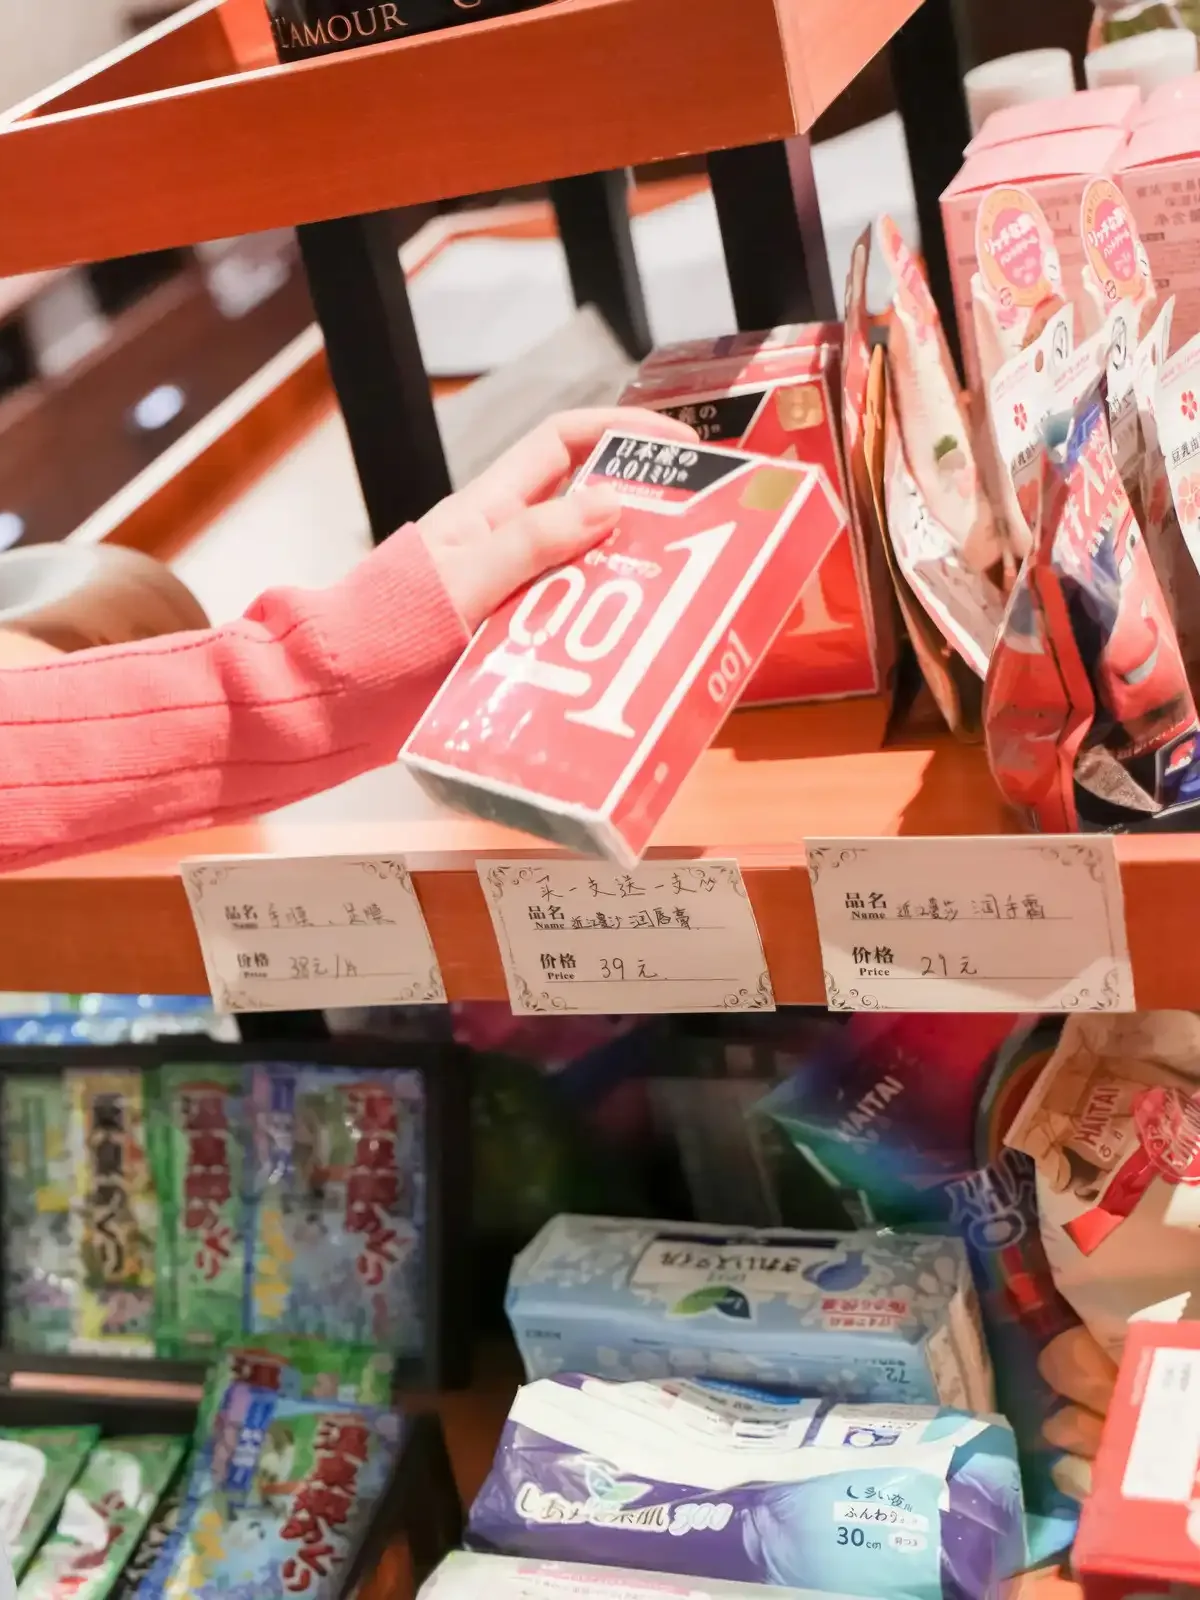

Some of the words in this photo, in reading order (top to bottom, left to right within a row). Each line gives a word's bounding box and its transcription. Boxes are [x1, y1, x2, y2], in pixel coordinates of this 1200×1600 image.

[616, 438, 698, 467] 日本産の
[707, 629, 753, 703] 001
[845, 892, 887, 909] 品名
[225, 904, 258, 920] 品名
[528, 905, 565, 921] 品名
[852, 910, 886, 920] Name
[535, 922, 565, 930] Name
[237, 953, 269, 968] 价格
[540, 953, 576, 970] 价格
[852, 946, 894, 965] 价格
[547, 971, 575, 980] Price
[859, 967, 890, 977] Price
[1075, 1087, 1119, 1147] HAITAI
